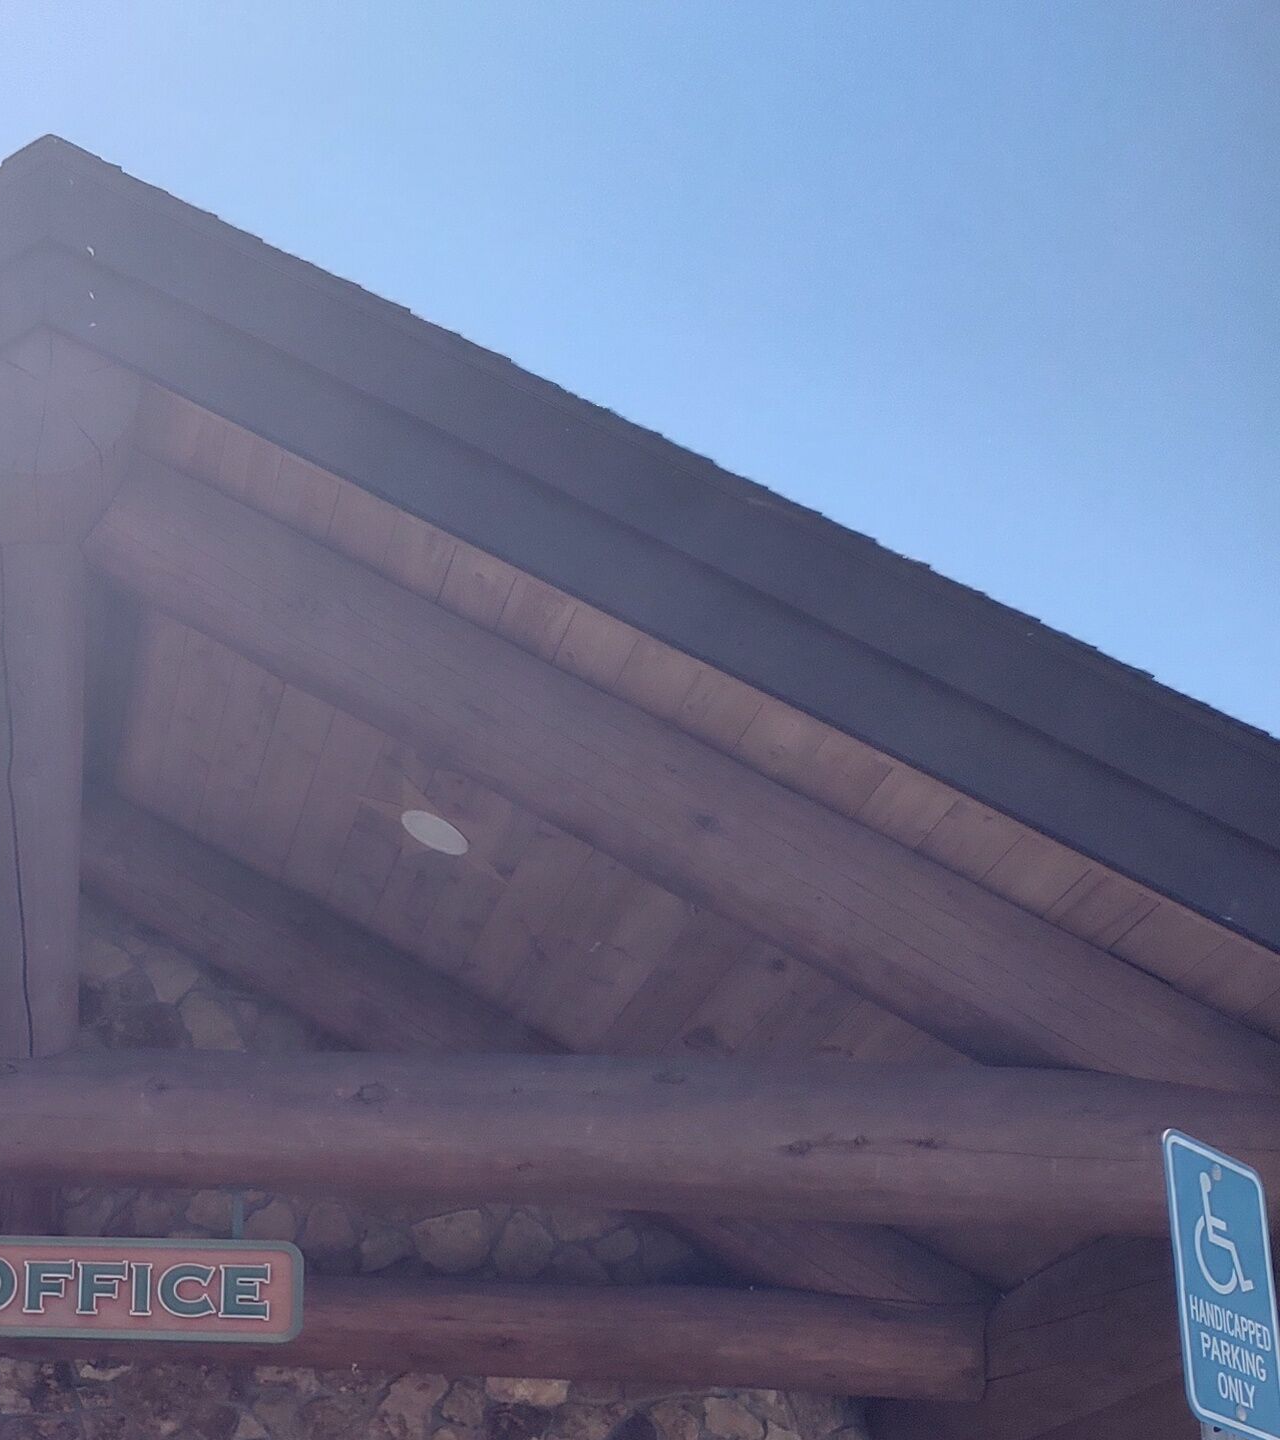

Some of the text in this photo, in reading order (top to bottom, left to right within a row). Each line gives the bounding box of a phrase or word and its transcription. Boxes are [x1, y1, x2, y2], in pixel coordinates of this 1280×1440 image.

[1189, 1294, 1272, 1351] HANDICAPPED
[1200, 1331, 1267, 1382] PARKING
[1217, 1371, 1255, 1409] ONLY
